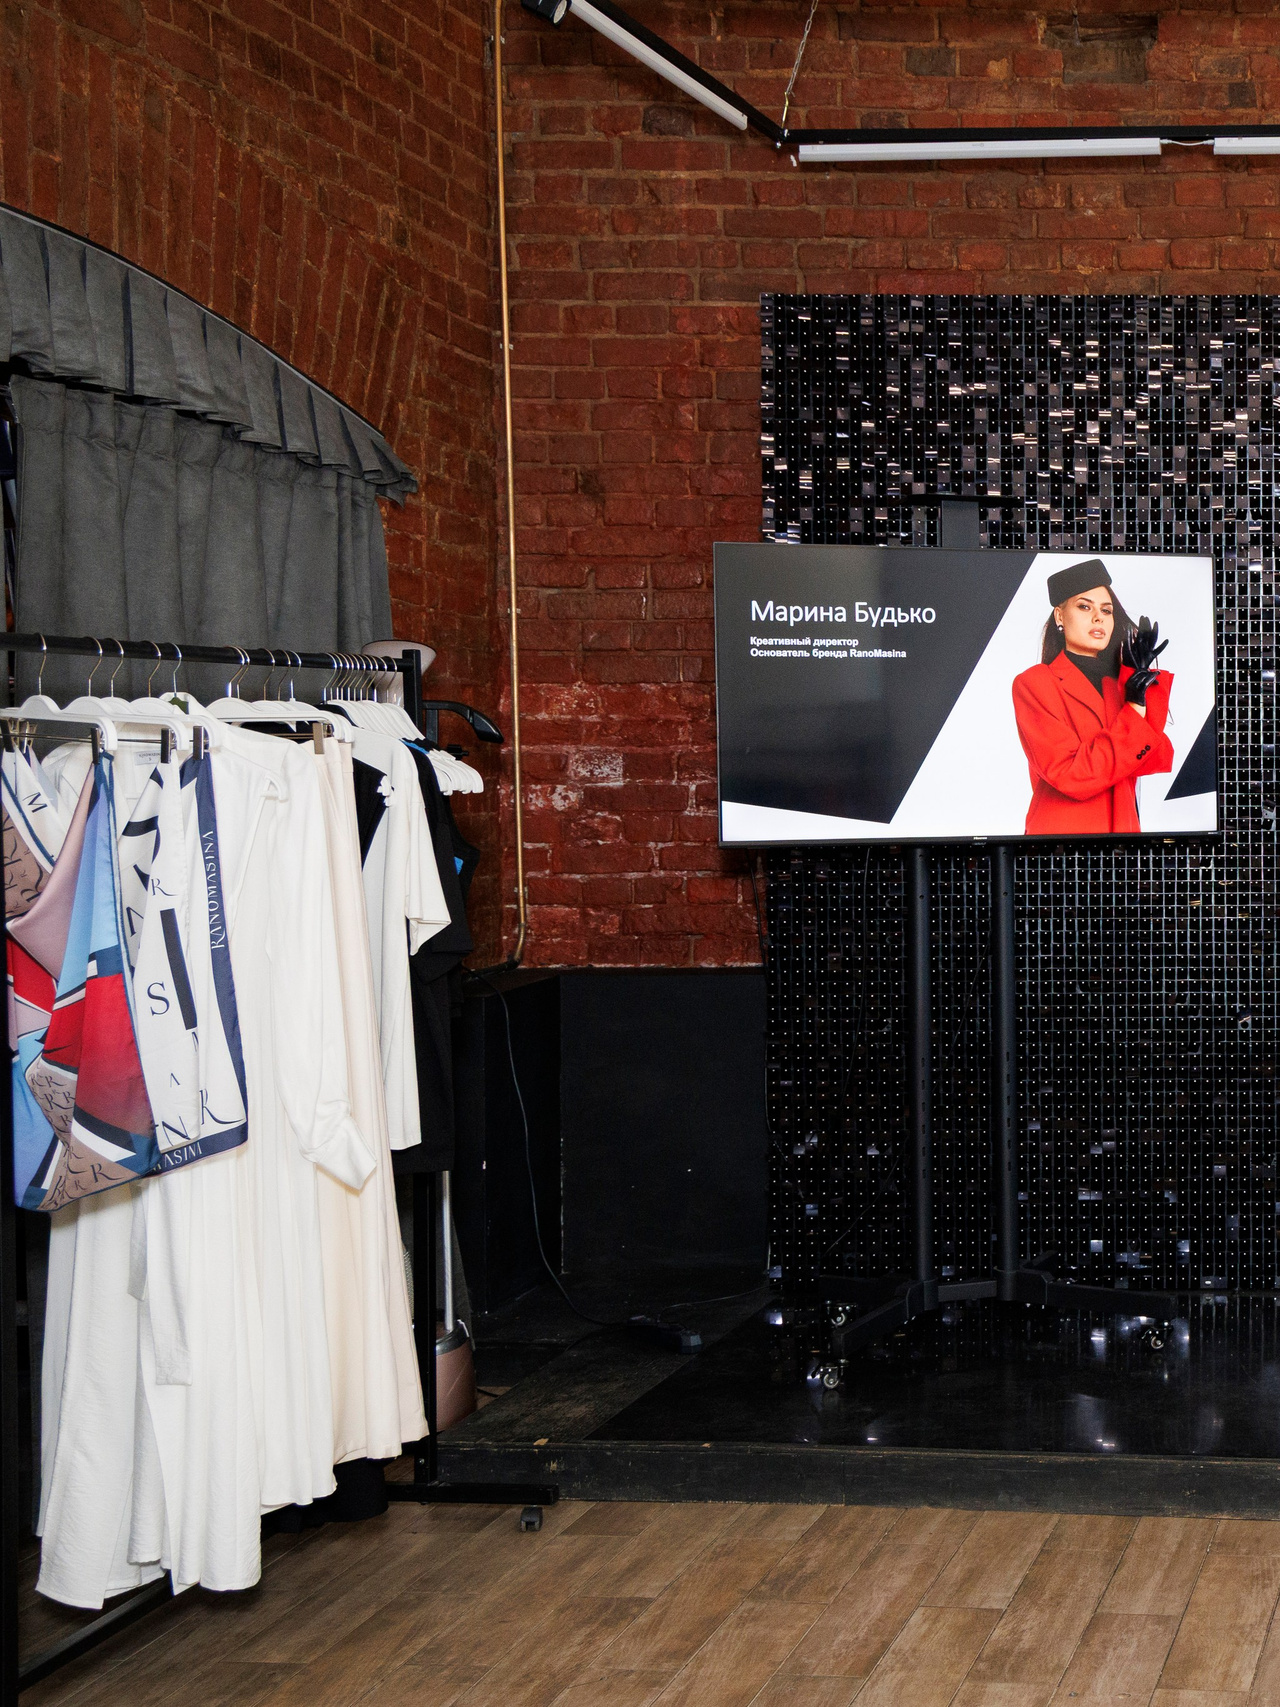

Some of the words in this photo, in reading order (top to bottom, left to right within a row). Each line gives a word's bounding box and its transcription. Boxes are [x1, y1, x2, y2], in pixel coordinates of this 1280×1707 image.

[751, 600, 847, 626] Марина
[854, 601, 936, 627] Будько
[750, 636, 811, 647] Креативный
[813, 638, 859, 648] директор
[750, 648, 810, 658] Основатель
[812, 649, 847, 659] бренда
[849, 649, 907, 659] RanoMasina
[151, 878, 178, 897] R
[202, 830, 226, 949] RANOMASINA
[147, 981, 170, 1017] S
[199, 1088, 244, 1125] R
[90, 1163, 124, 1183] R
